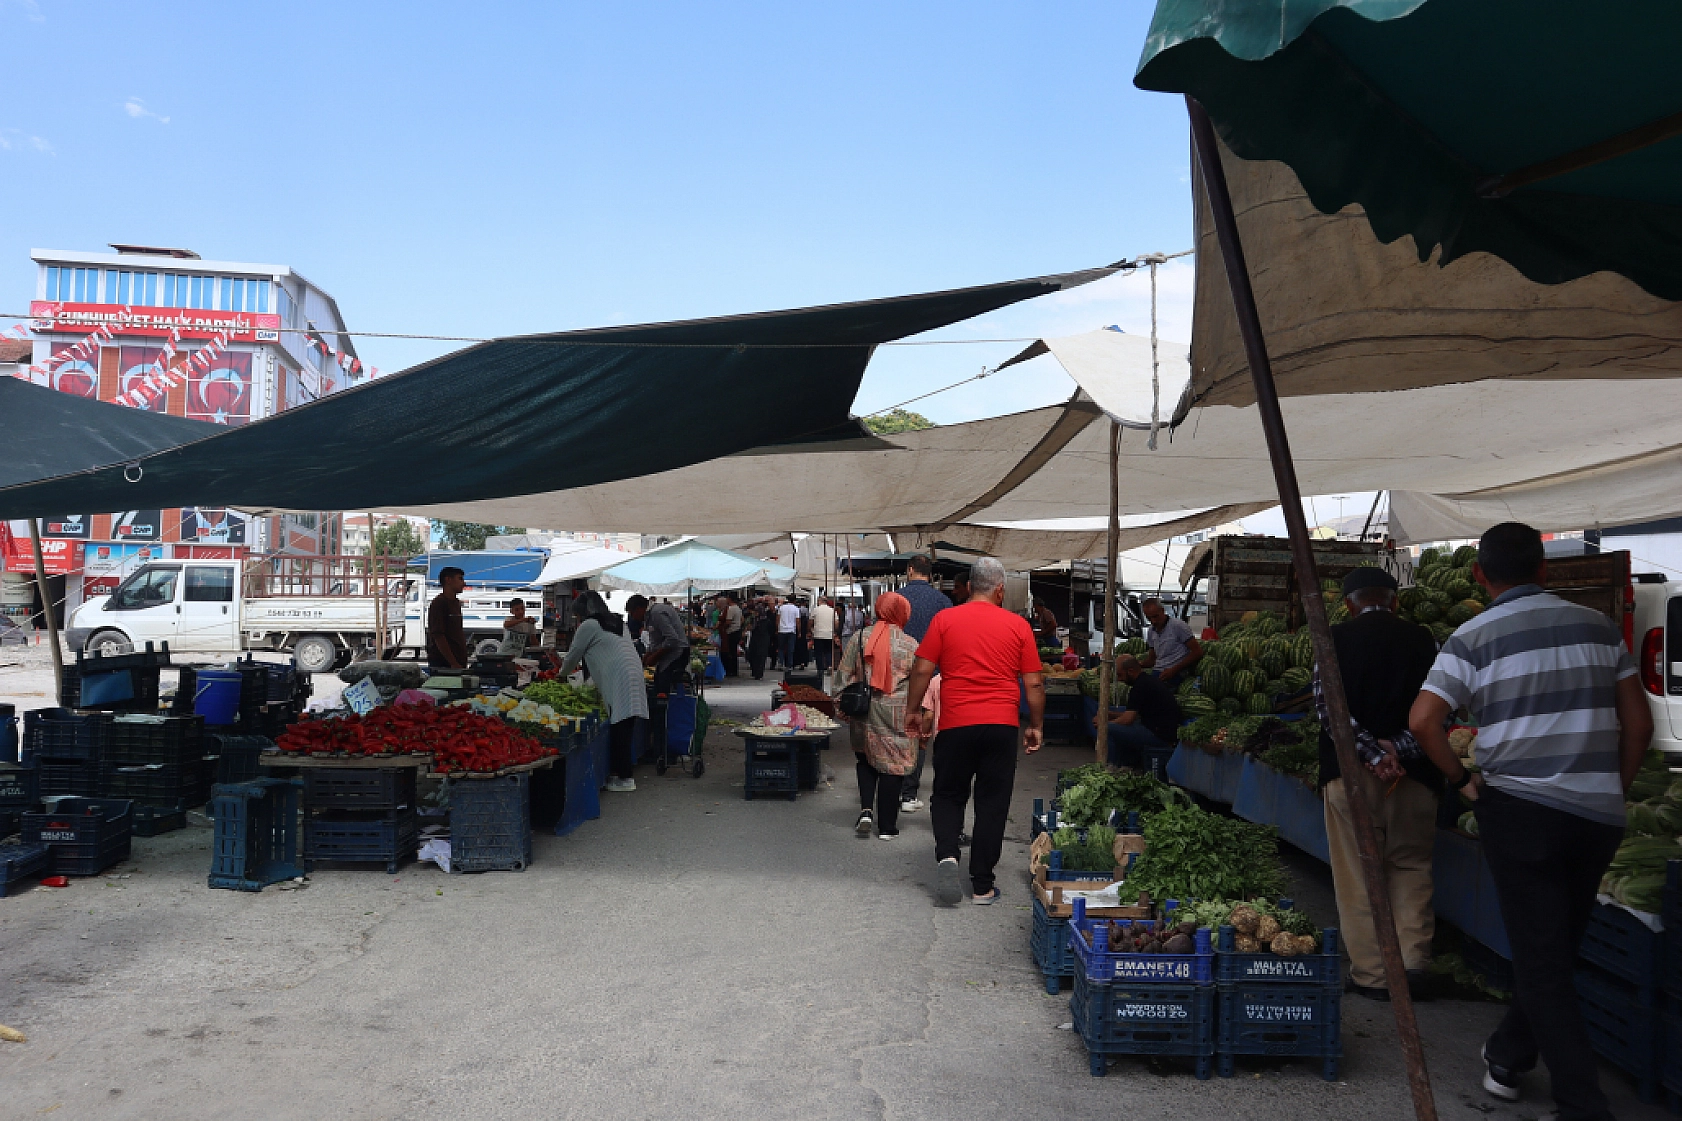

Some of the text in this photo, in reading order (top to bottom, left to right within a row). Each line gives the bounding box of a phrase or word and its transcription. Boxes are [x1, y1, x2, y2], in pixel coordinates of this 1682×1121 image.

[58, 311, 150, 328] CUMHURYET
[153, 314, 192, 330] HALK
[1115, 961, 1174, 970] EMANET
[1253, 961, 1305, 970] MALATYA
[1115, 970, 1174, 978] MALATYA
[1246, 1012, 1312, 1021] MALATYA
